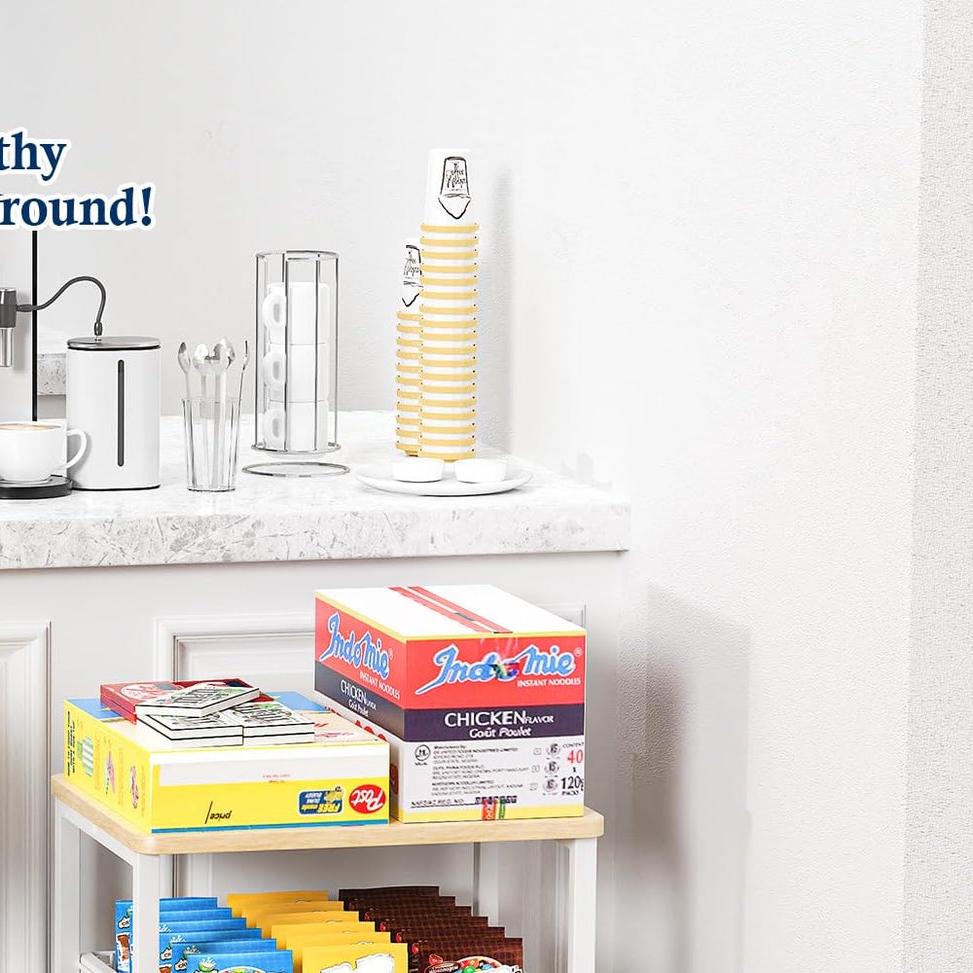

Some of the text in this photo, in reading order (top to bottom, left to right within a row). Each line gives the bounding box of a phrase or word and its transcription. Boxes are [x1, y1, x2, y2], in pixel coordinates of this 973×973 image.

[517, 677, 581, 688] INSTANT NOODLES
[340, 679, 367, 704] CHICKEN
[444, 710, 554, 727] CHICKEN FLAVOR
[566, 749, 583, 764] 40
[351, 790, 384, 811] Post
